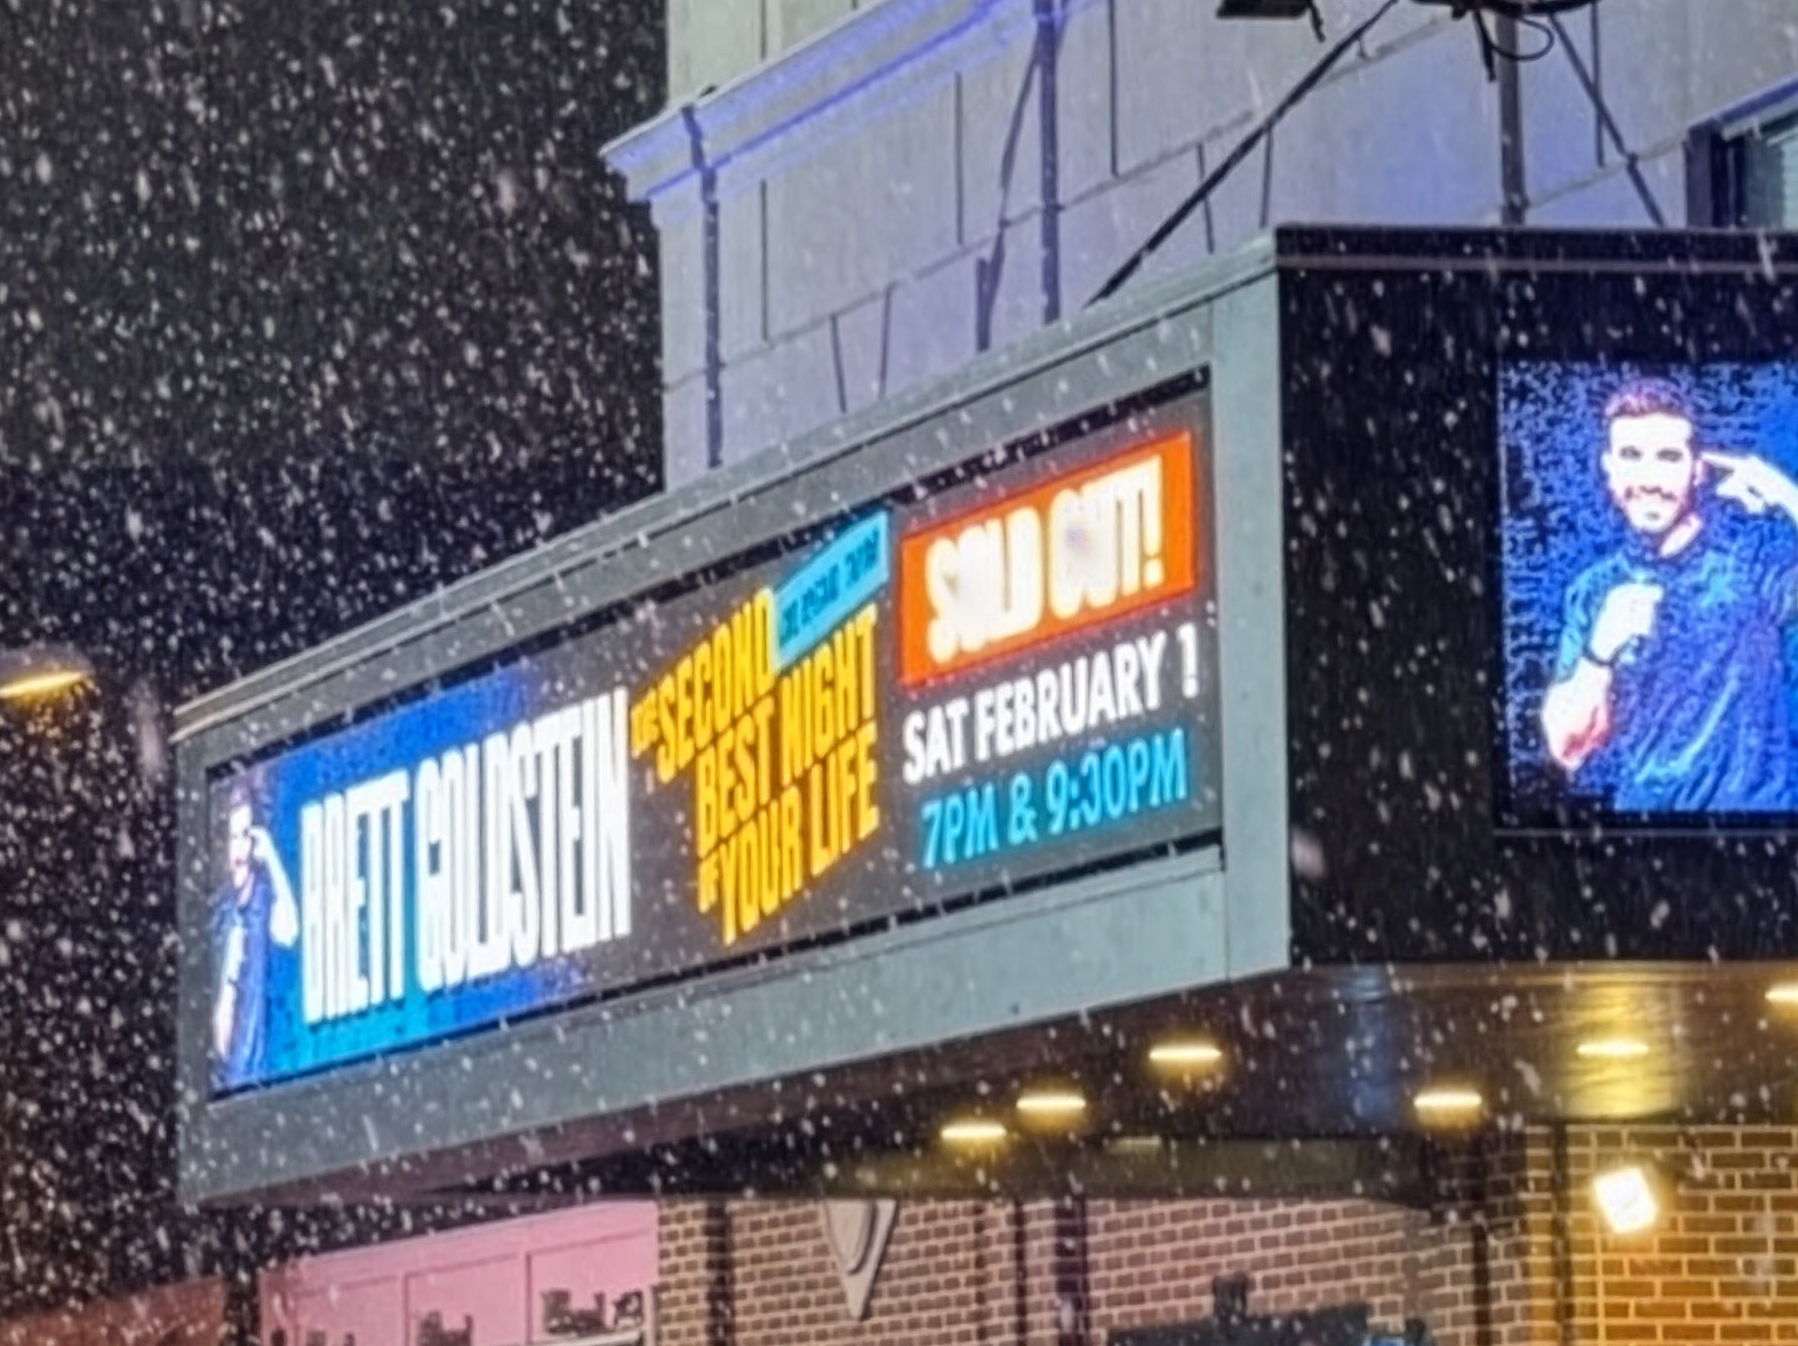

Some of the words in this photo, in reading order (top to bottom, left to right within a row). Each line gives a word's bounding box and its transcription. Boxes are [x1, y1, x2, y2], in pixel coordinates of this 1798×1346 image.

[925, 505, 1045, 664] SOLD
[1048, 454, 1165, 620] OUT!
[656, 586, 779, 785] SECOND
[695, 695, 777, 858] BEST
[778, 600, 879, 787] NIGHT
[903, 698, 972, 784] SAT
[974, 630, 1168, 762] FEBRUARY
[300, 769, 410, 1024] BRETT
[413, 685, 632, 992] GOLDSTEIN
[718, 783, 803, 946] YOUR
[809, 720, 880, 878] LIFE
[921, 782, 999, 870] 7PM
[1007, 772, 1038, 847] &
[1045, 726, 1188, 836] 9:30PM
